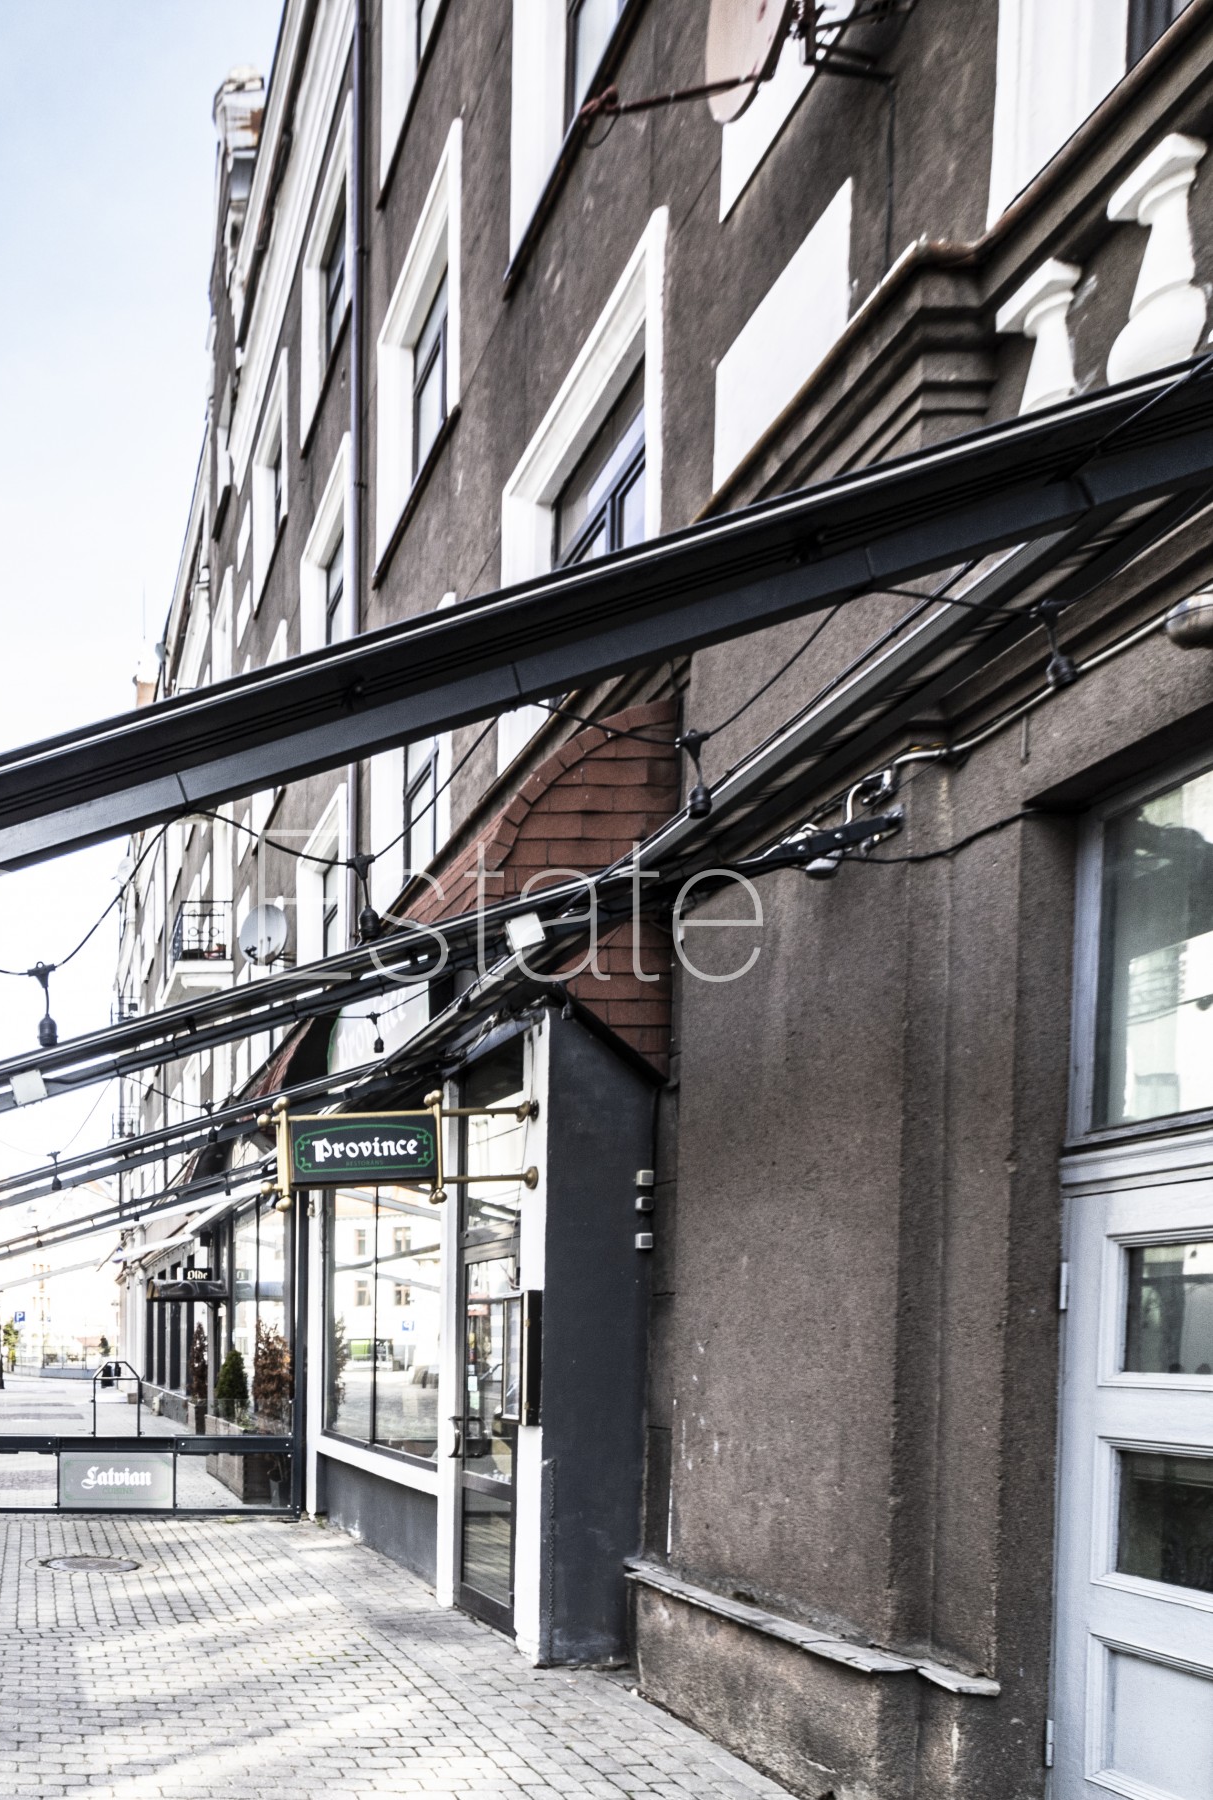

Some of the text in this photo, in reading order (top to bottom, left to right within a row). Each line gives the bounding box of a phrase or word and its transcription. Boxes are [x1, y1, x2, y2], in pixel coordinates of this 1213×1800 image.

[311, 1137, 418, 1162] Province
[187, 1270, 208, 1280] Olde
[81, 1466, 152, 1489] Latvian
